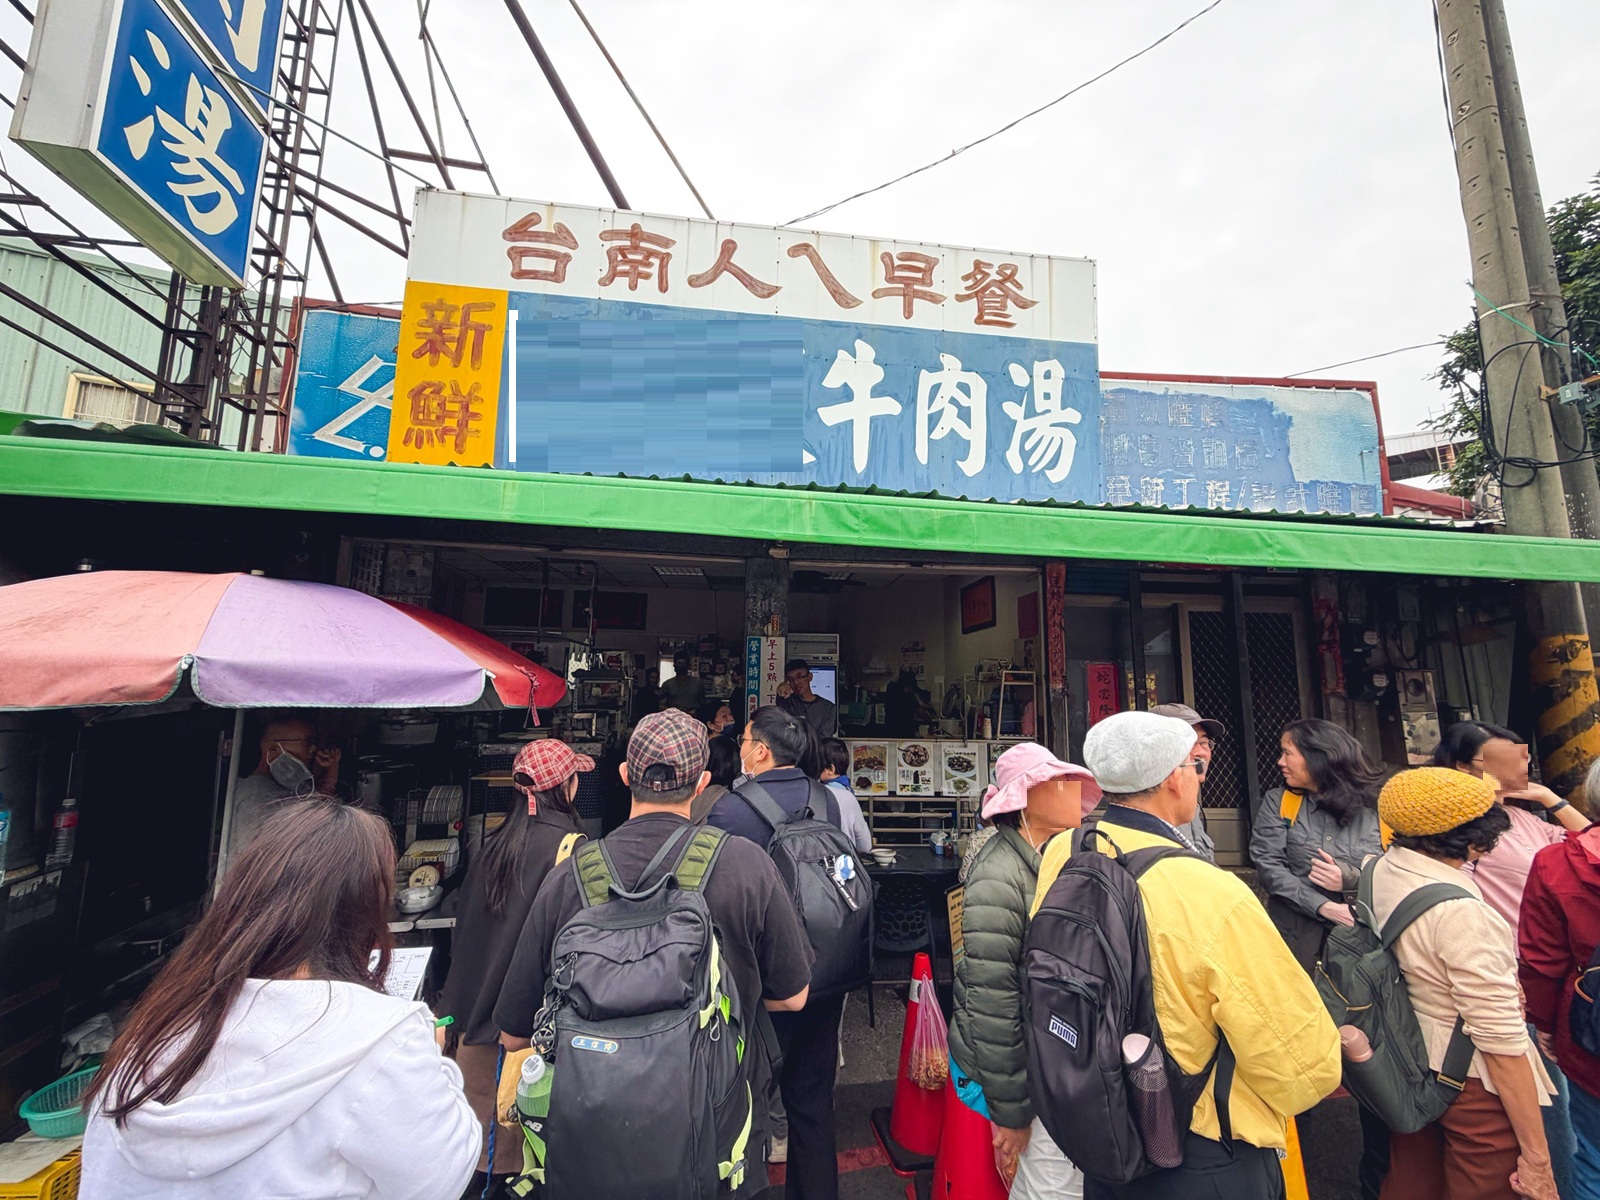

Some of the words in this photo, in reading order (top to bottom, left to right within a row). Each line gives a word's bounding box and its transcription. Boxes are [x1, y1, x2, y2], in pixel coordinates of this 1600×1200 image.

[402, 298, 495, 455] 新鮮
[803, 339, 1082, 484] 牛肉湯
[748, 640, 759, 691] 營業時間
[1050, 1021, 1077, 1046] PUMA
